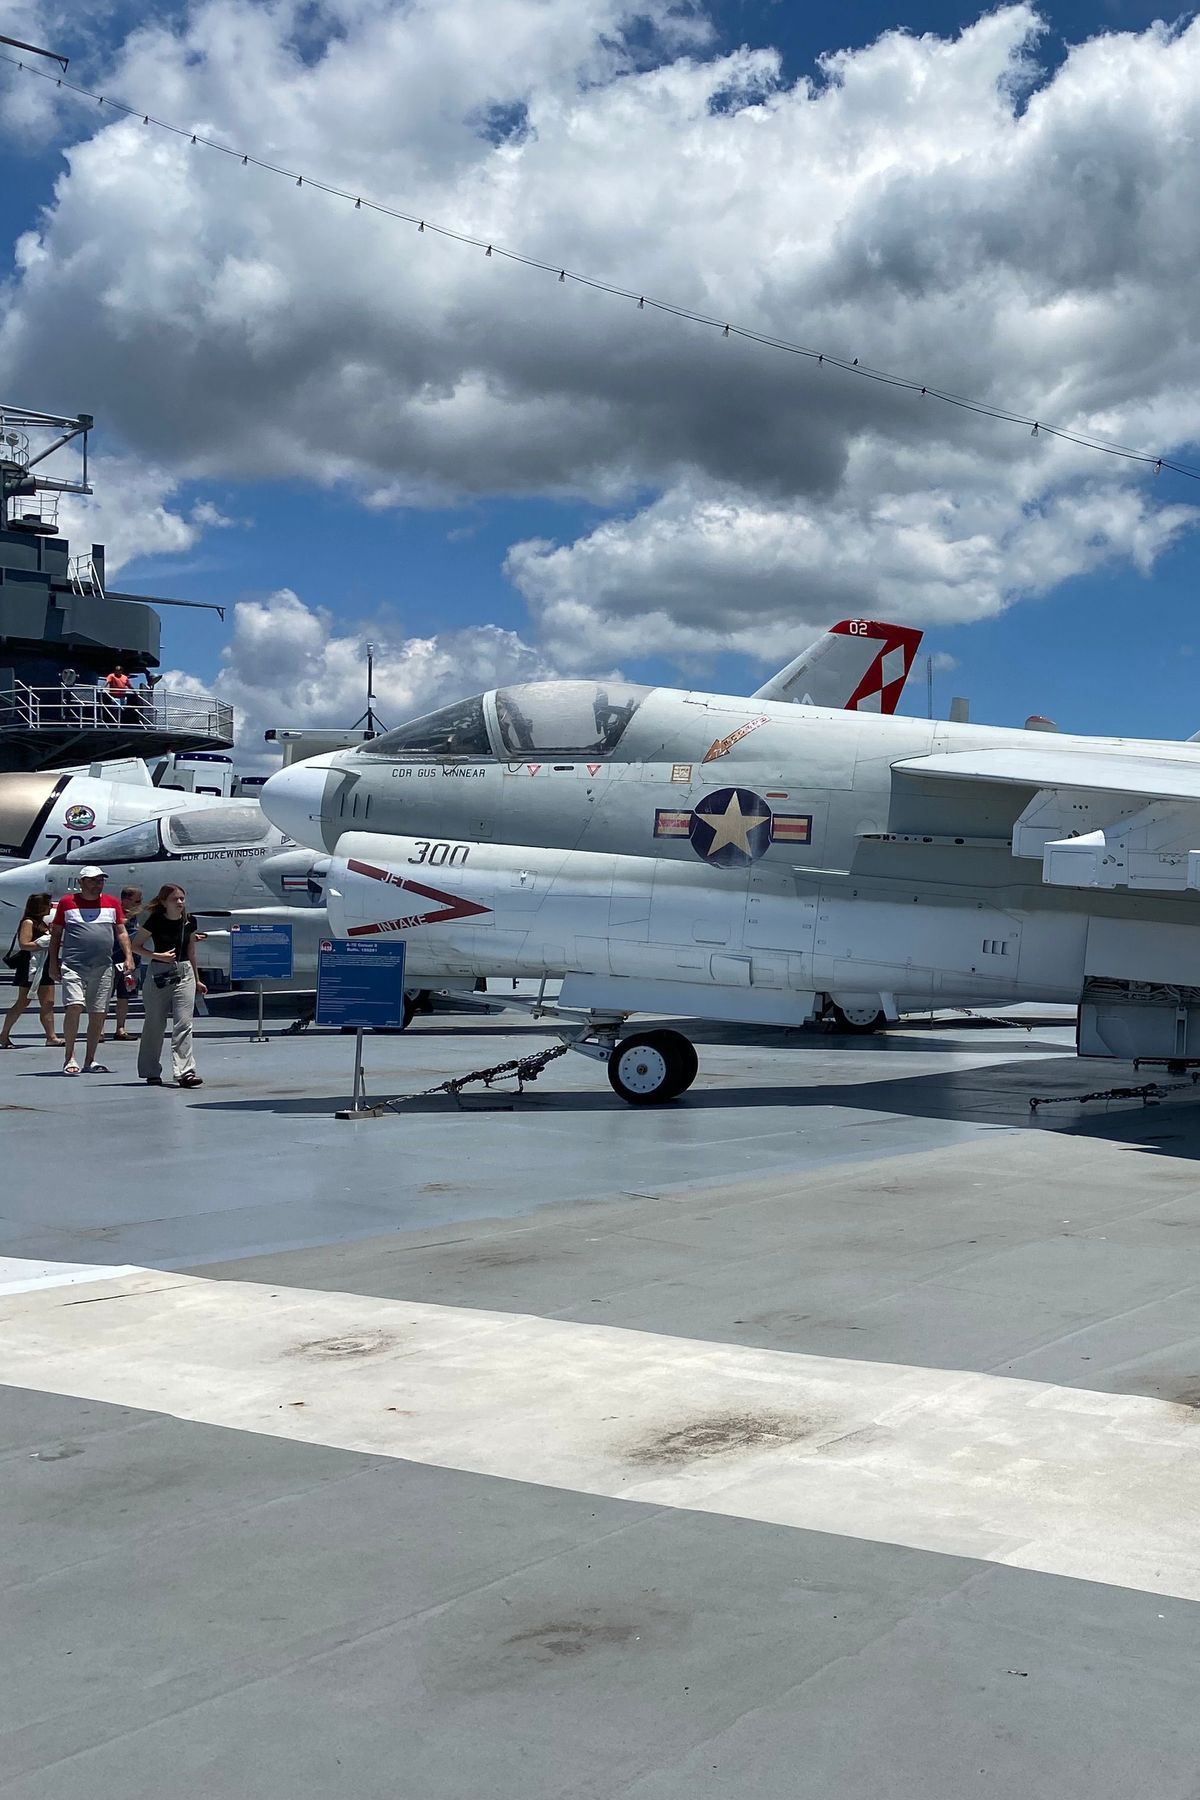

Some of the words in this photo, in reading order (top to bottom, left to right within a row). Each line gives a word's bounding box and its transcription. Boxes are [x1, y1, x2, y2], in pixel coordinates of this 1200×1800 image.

[849, 622, 868, 636] 02
[391, 768, 413, 778] CDR
[417, 768, 437, 778] GUS
[441, 768, 486, 778] KINNEAR
[45, 834, 104, 857] 70
[407, 841, 470, 868] 300
[381, 872, 408, 889] JET
[376, 916, 428, 933] INTAKE
